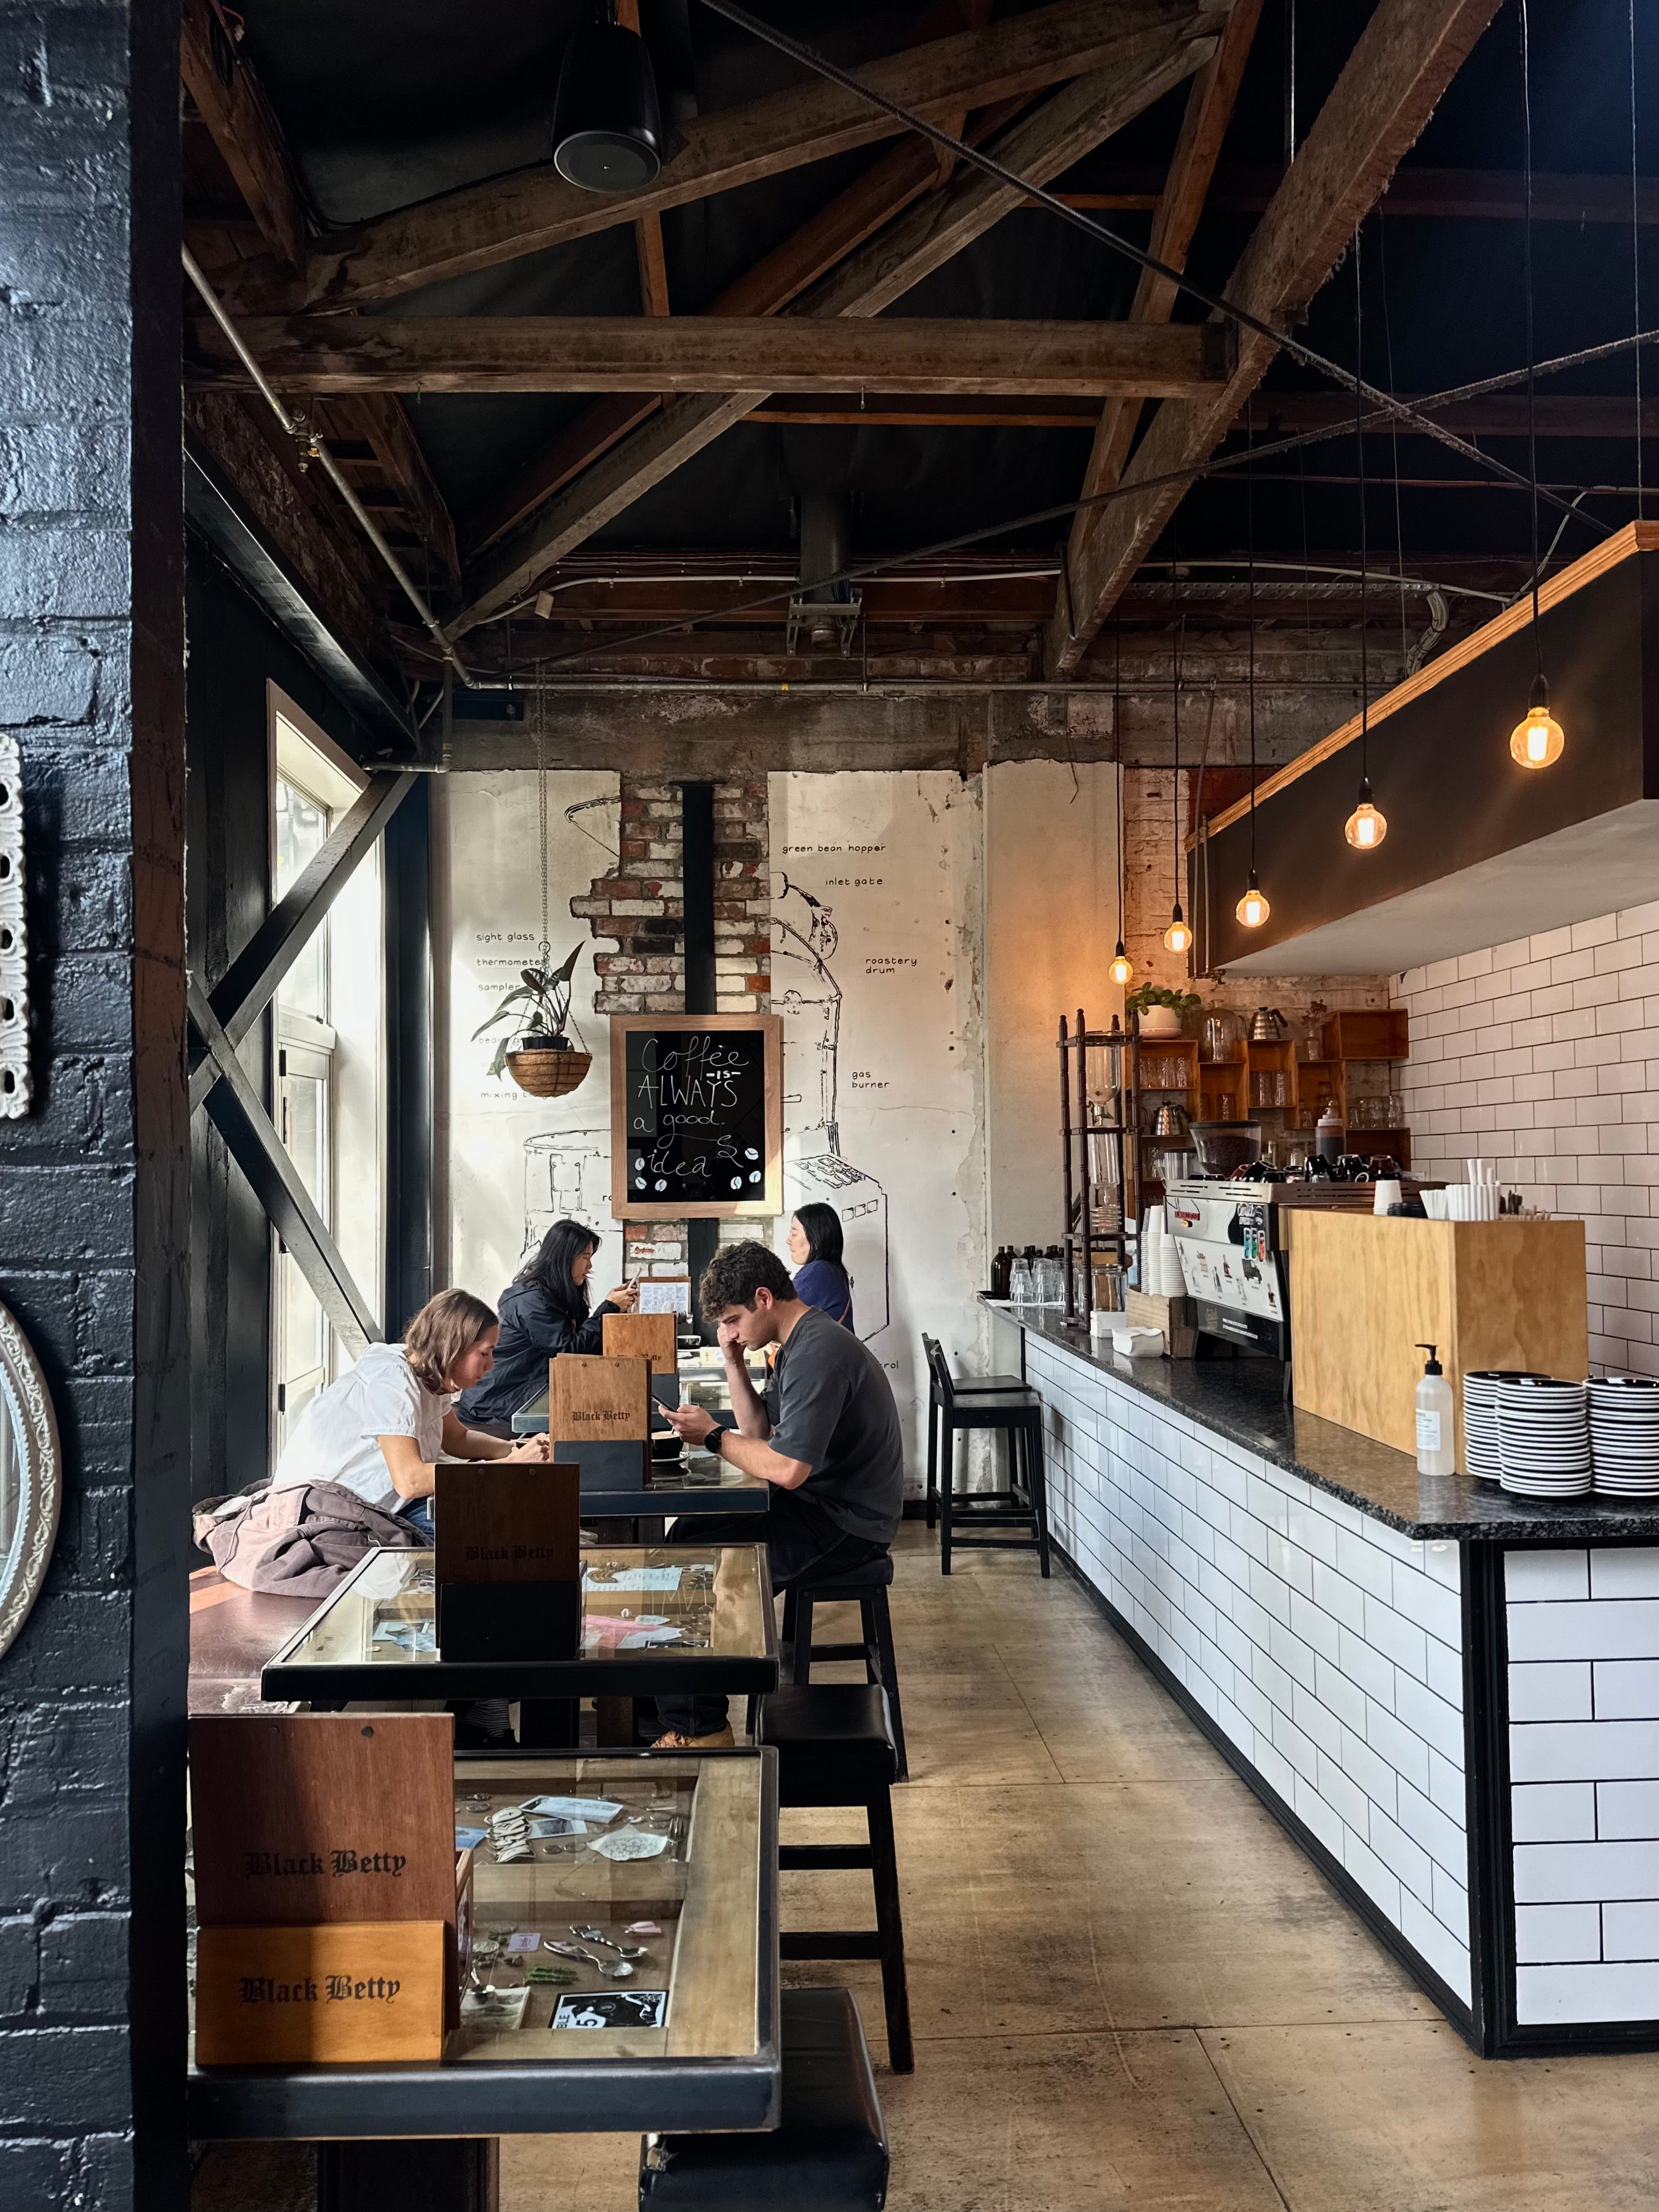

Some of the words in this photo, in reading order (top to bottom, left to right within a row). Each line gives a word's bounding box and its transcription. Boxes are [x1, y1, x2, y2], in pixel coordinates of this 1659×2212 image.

[782, 845, 812, 854] green
[849, 845, 887, 853] hopper
[826, 877, 850, 886] inlet
[854, 878, 883, 886] gate
[477, 932, 502, 943] sight
[507, 932, 535, 942] glass
[866, 957, 917, 966] roastery
[478, 982, 521, 991] sampler
[642, 1036, 749, 1080] Coffee
[852, 1072, 871, 1080] gas
[638, 1075, 737, 1109] ALWAYS
[633, 1117, 654, 1132] a
[657, 1110, 724, 1149] good
[647, 1149, 712, 1177] idea
[572, 1411, 600, 1423] Black
[603, 1410, 630, 1422] Betty
[465, 1546, 509, 1560] Black
[513, 1545, 553, 1560] Betty
[244, 1852, 323, 1880] Black
[331, 1850, 406, 1877] Betty
[238, 1977, 318, 2007] Black
[325, 1975, 400, 2004] Betty
